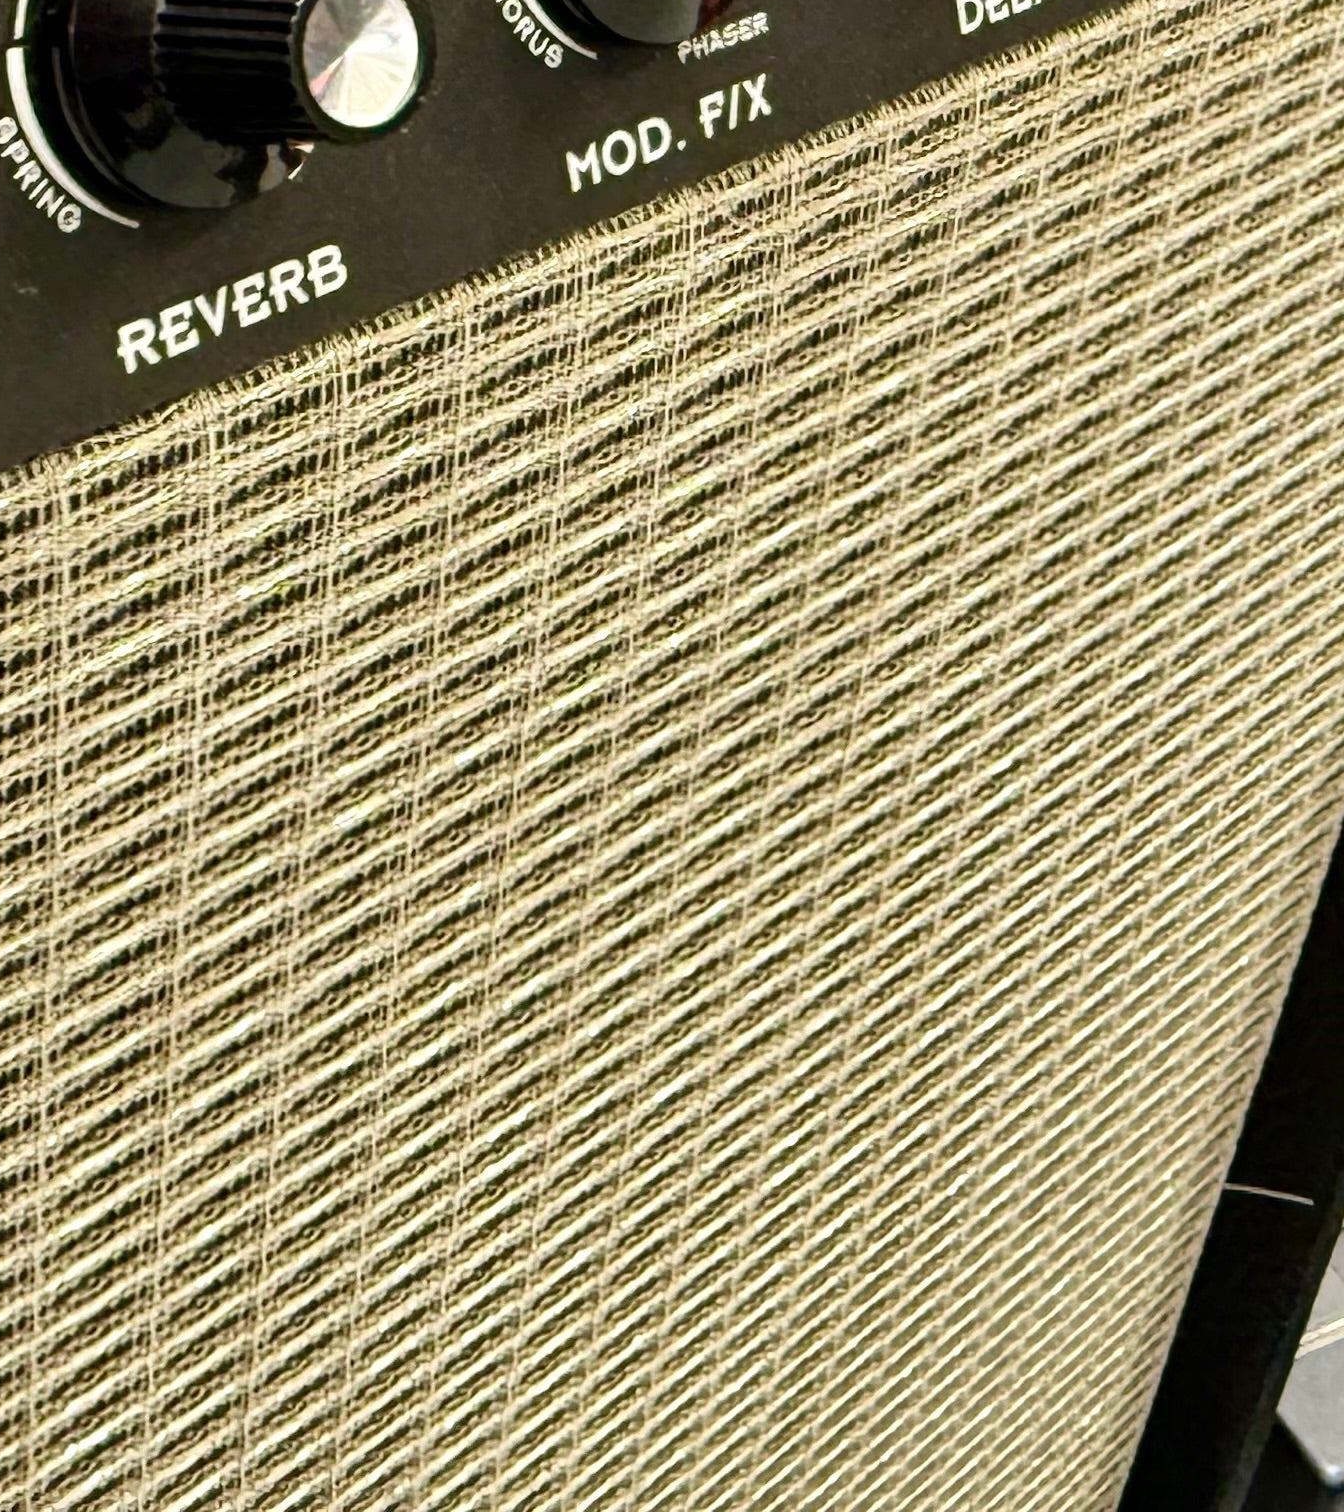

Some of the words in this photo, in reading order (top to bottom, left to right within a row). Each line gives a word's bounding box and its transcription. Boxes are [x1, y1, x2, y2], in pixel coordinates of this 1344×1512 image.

[677, 11, 770, 64] PHASER
[565, 117, 688, 193] MOD.
[699, 73, 772, 139] F/X
[116, 243, 349, 374] REVERB
